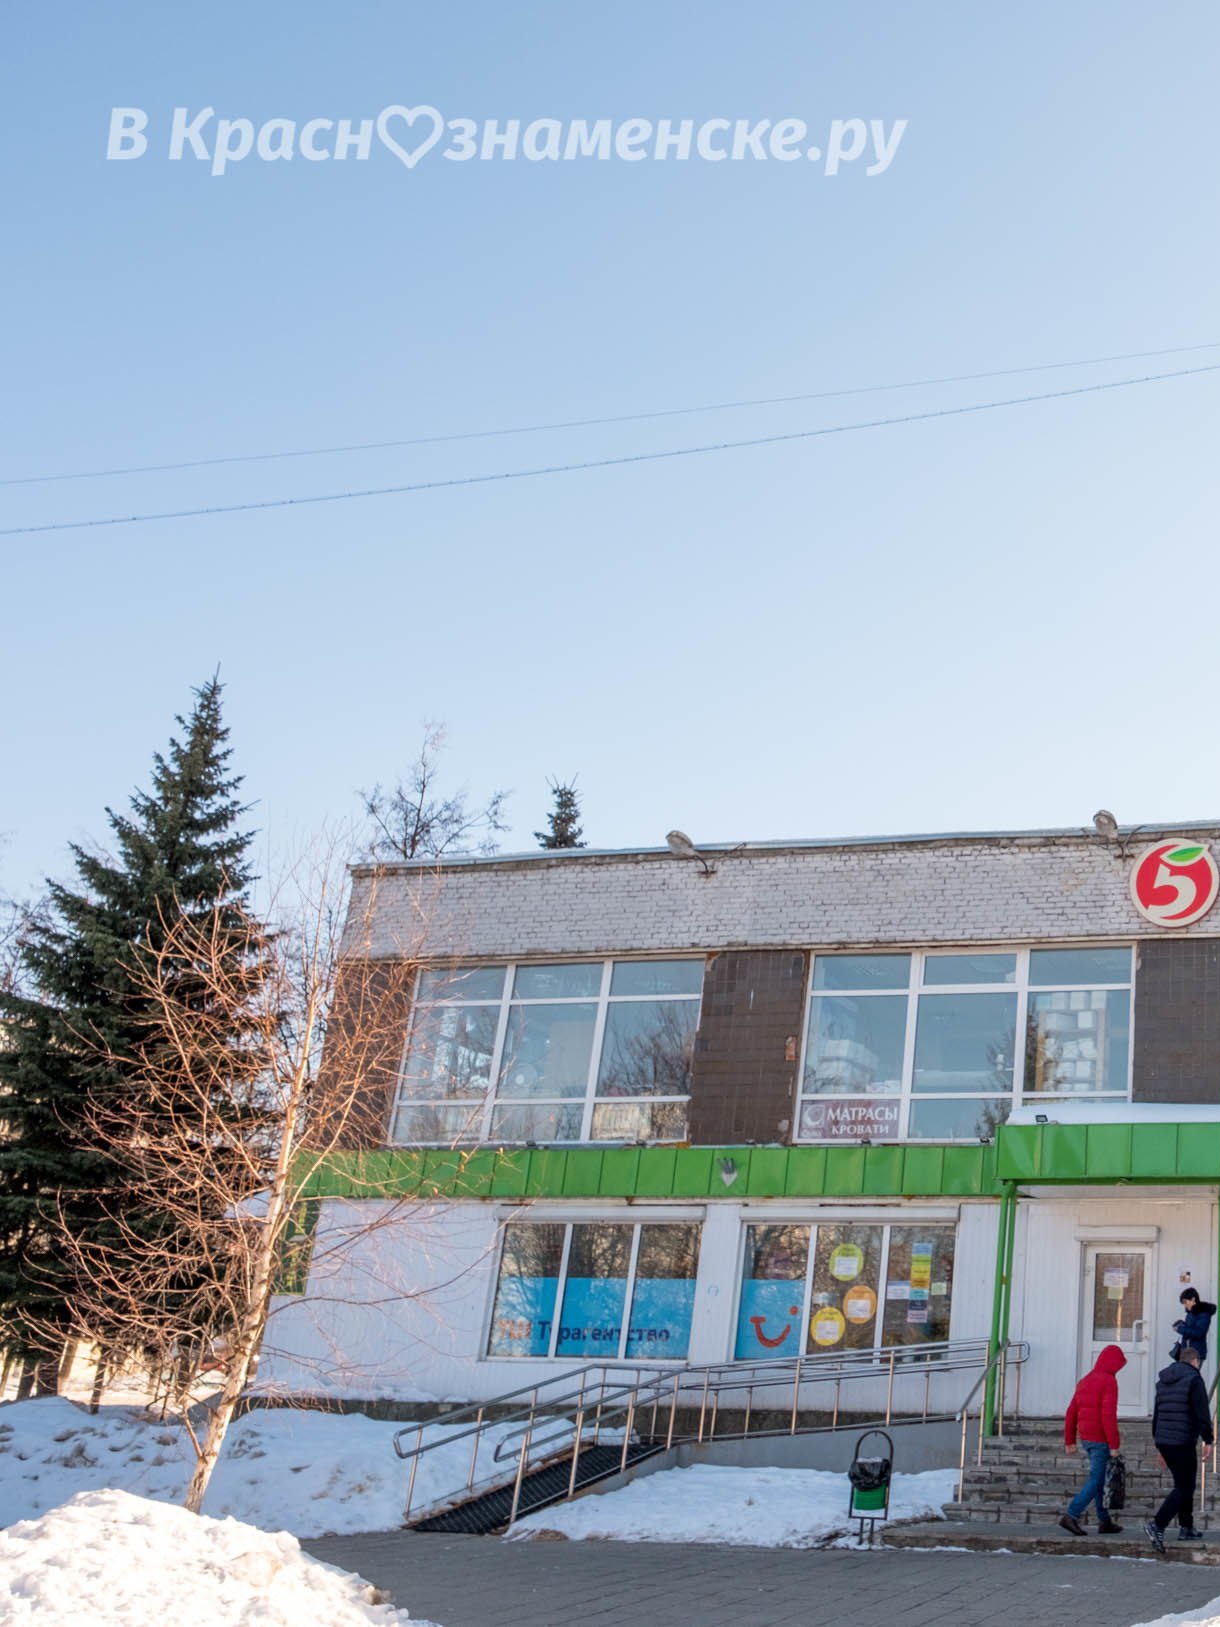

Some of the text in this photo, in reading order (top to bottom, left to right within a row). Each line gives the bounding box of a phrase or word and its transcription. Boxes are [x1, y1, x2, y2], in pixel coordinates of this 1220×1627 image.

[1146, 863, 1197, 919] 5
[826, 1106, 898, 1121] МАТРАСЫ
[831, 1124, 889, 1136] КРОВАТИ
[538, 1320, 671, 1344] Трагентство
